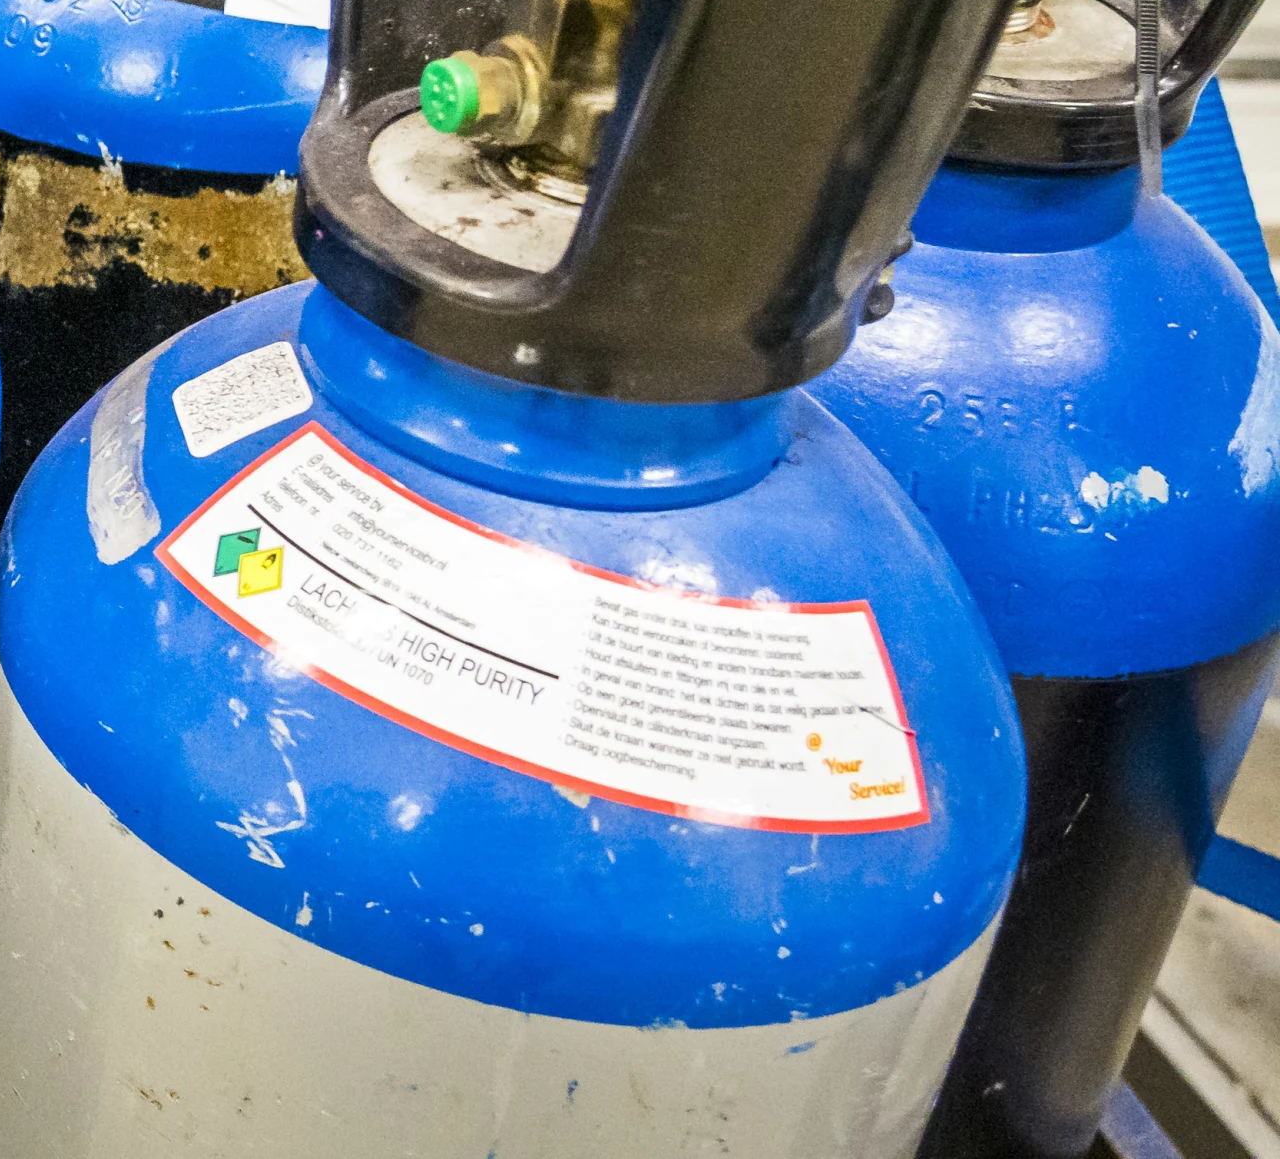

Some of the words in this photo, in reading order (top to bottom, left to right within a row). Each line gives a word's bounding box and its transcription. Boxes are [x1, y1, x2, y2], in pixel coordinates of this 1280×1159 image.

[307, 453, 324, 468] @
[320, 462, 340, 482] your
[336, 479, 370, 505] service
[369, 499, 385, 513] bv
[259, 489, 284, 513] Adres
[332, 523, 353, 542] 020
[377, 649, 397, 669] UN
[402, 662, 434, 686] 1070
[398, 630, 456, 672] HIGH
[458, 657, 545, 706] PURITY
[823, 757, 863, 775] Your
[849, 776, 906, 800] Service!
